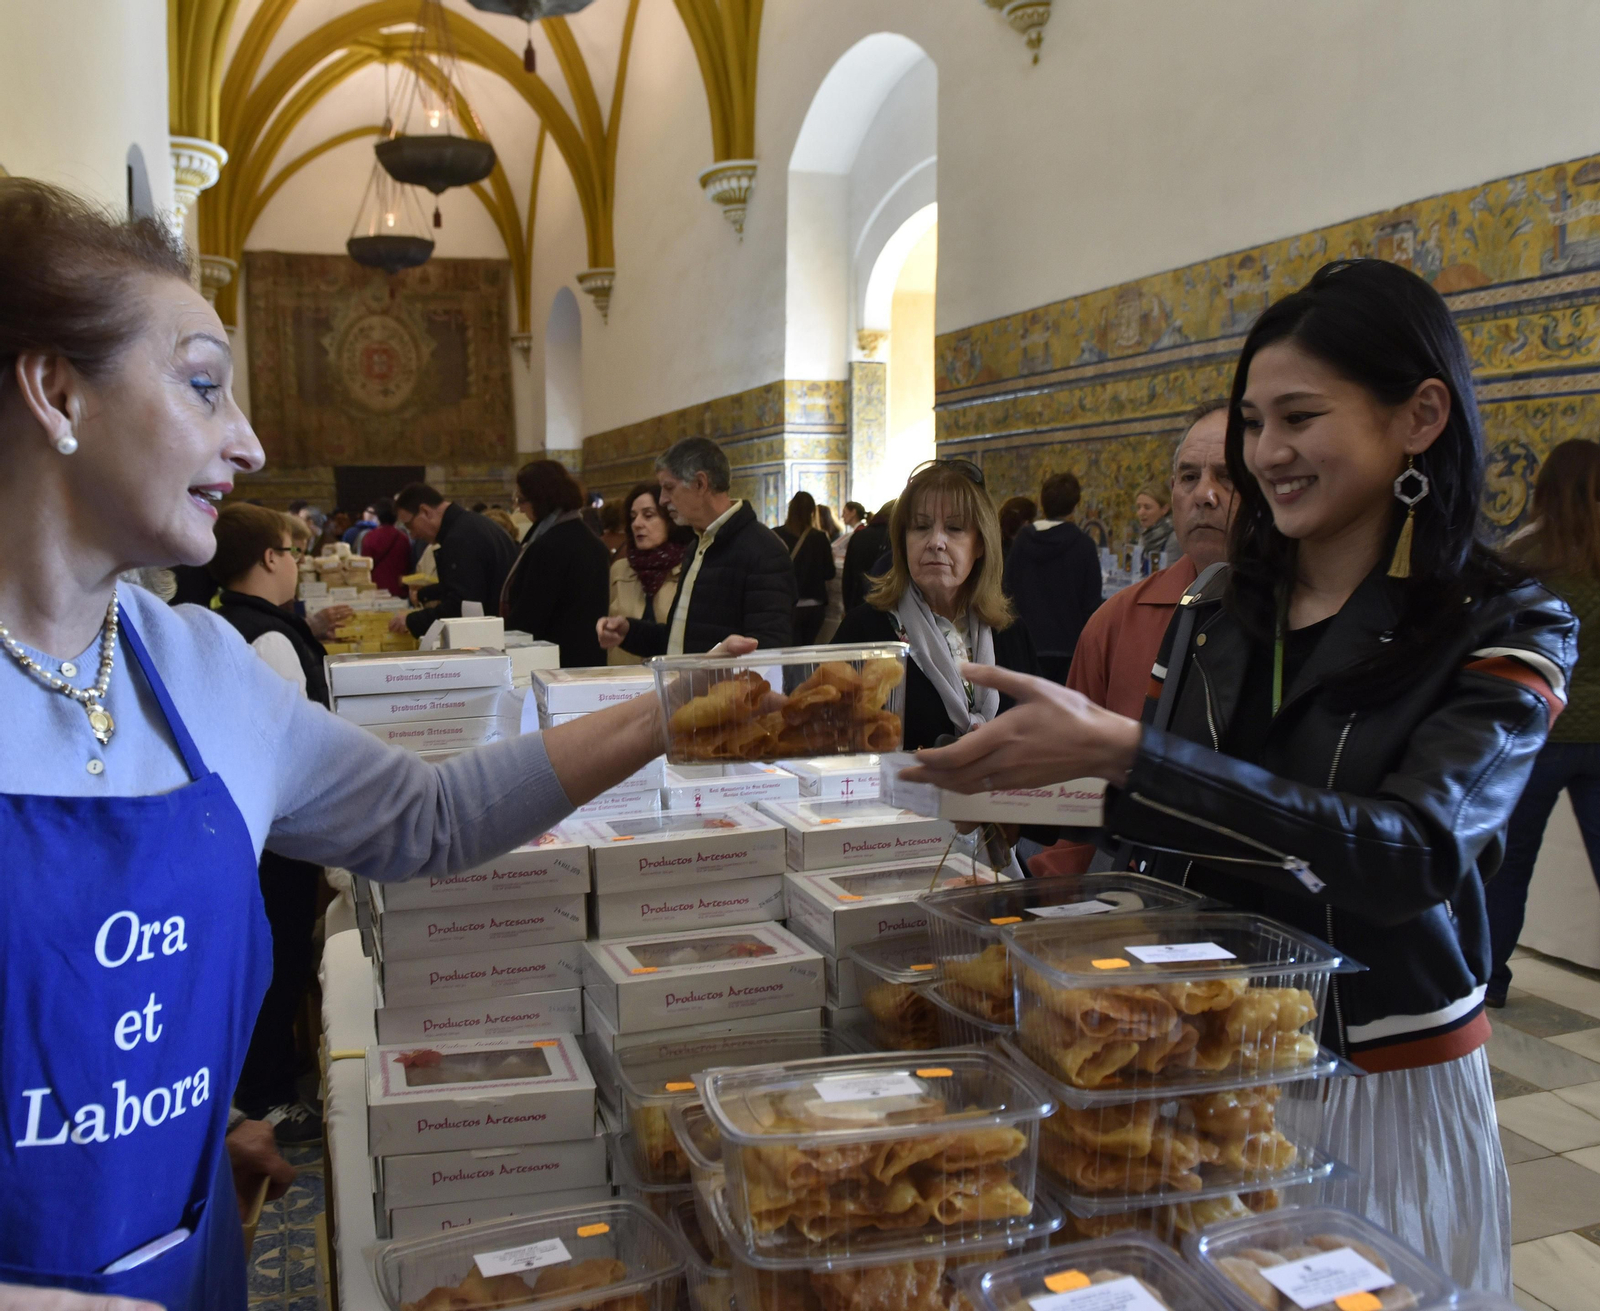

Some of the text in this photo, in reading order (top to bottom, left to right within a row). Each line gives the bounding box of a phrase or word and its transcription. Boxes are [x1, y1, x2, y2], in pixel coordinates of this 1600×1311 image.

[385, 671, 461, 683] Productos Artesanos
[390, 701, 466, 713] Productos Artesanos
[388, 727, 463, 739] Productos Artesanos
[842, 840, 892, 855] Productos
[894, 836, 942, 848] Artesanos
[639, 857, 692, 872] Productos
[696, 851, 748, 863] Artesanos
[430, 873, 488, 888] Productos
[491, 867, 548, 880] Artesanos
[641, 902, 694, 917] Productos
[698, 897, 750, 909] Artesanos
[428, 922, 485, 938] Productos
[489, 917, 545, 929] Artesanos
[878, 918, 928, 934] Producto
[94, 910, 188, 968] Ora
[429, 969, 487, 985] Productos
[490, 963, 547, 976] Artesanos
[665, 991, 724, 1008] Productos
[728, 982, 784, 997] Artesanos
[114, 992, 163, 1051] et
[423, 1017, 481, 1033] Productos
[484, 1011, 541, 1024] Artesanos
[15, 1066, 210, 1148] Labora
[417, 1112, 547, 1134] Productos Artesanos
[432, 1161, 560, 1186] Productos Artesanos
